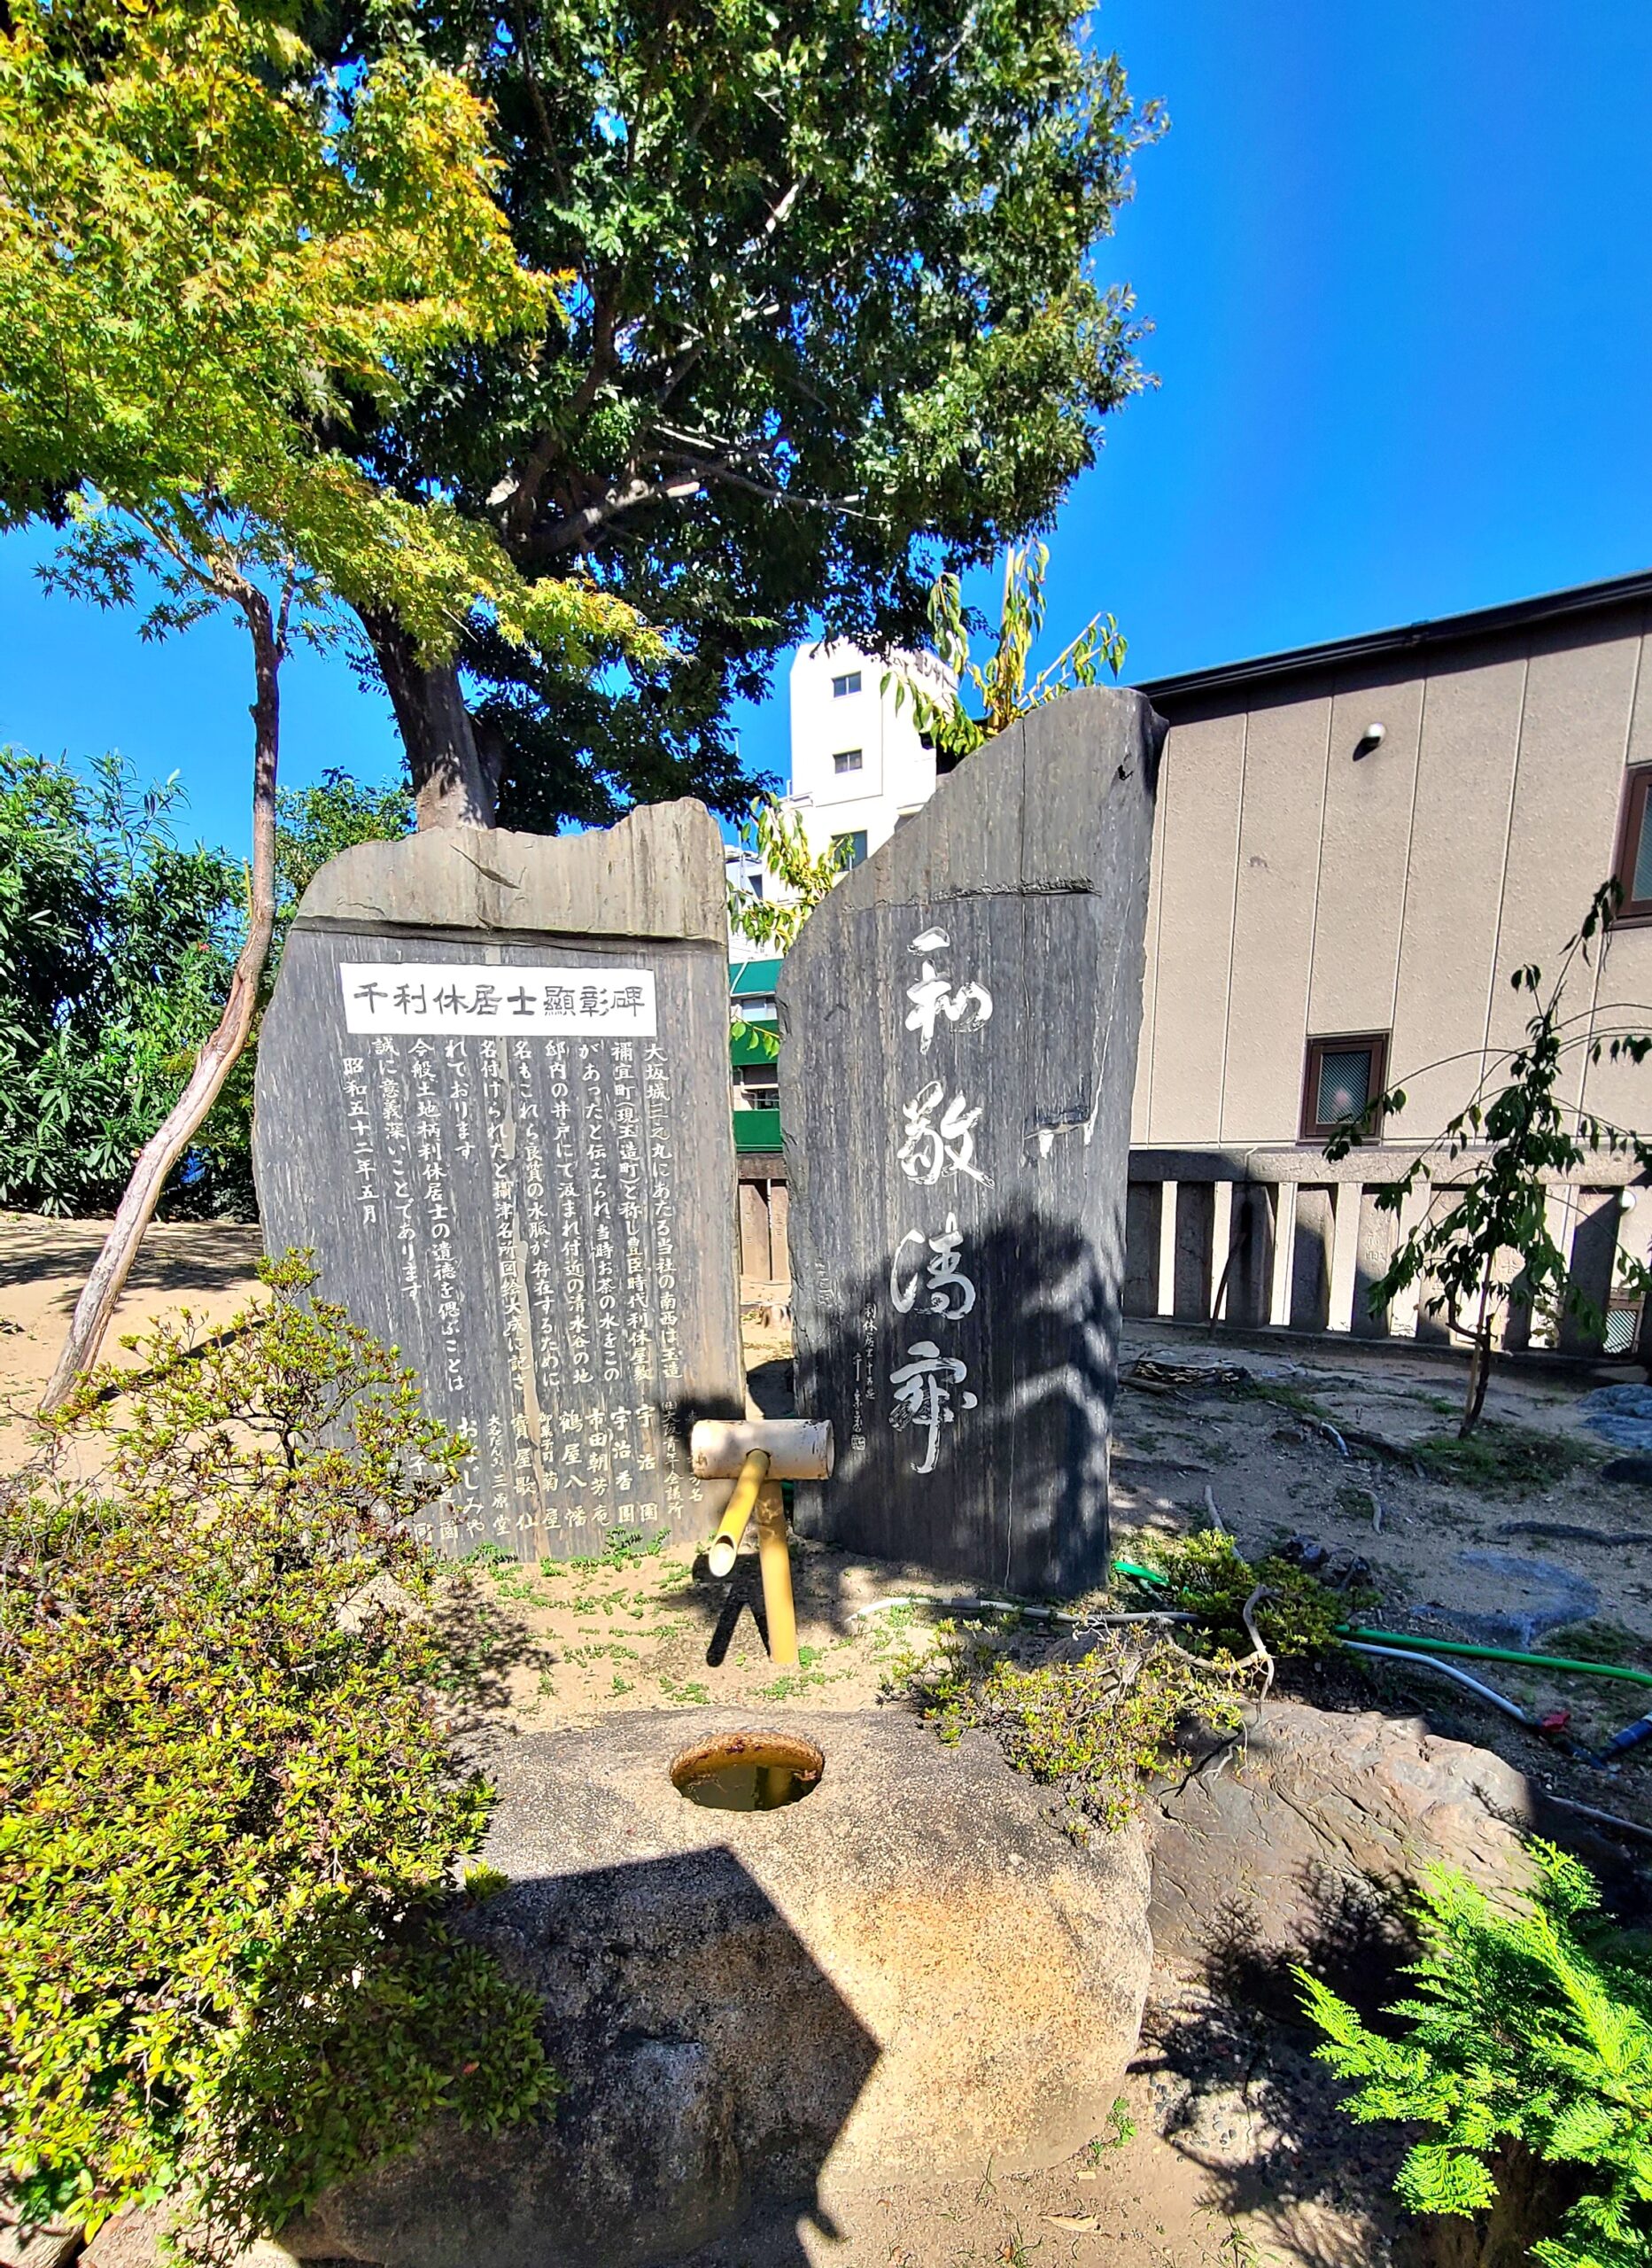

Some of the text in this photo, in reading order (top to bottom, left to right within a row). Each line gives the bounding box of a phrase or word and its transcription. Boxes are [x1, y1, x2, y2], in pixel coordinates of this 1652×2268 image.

[353, 981, 645, 1017] 千利休居士顯彰碑
[343, 1058, 379, 1223] 昭和五十二年五月
[445, 1041, 476, 1160] れております
[372, 1037, 422, 1300] 誠に意義深いことであります
[491, 1474, 511, 1535] 三原堂
[542, 1471, 562, 1530] 菊屋
[559, 1409, 587, 1528] 鶴屋八幡
[635, 1404, 658, 1522] 宇治園
